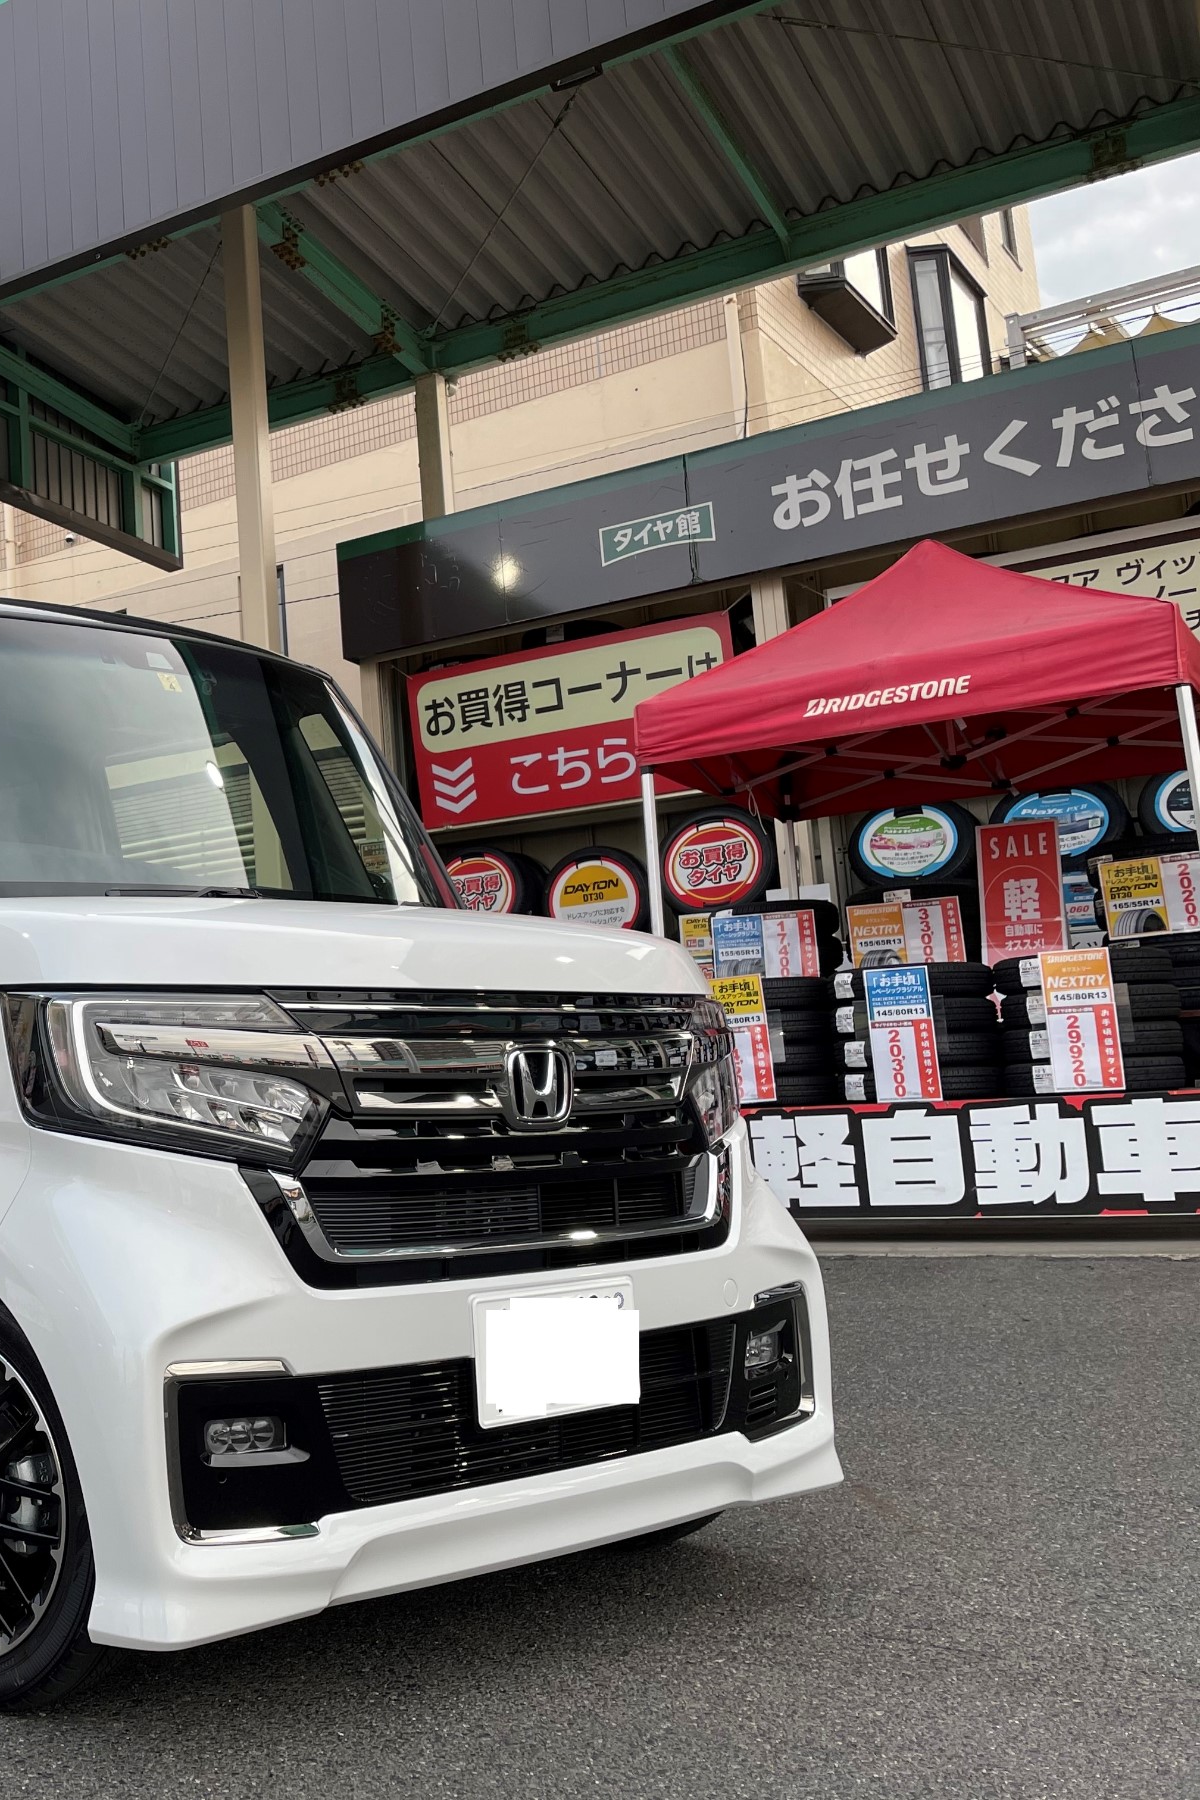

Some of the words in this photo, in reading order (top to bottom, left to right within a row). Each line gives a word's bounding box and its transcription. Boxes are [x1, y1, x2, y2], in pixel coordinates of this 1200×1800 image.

[771, 385, 1198, 530] お任せくださ
[614, 511, 701, 552] タイヤ館
[803, 675, 971, 717] BRIDGESTONE
[510, 738, 637, 795] こちら
[989, 832, 1048, 859] SALE
[680, 841, 748, 869] お買得
[687, 863, 742, 887] タイヤ
[564, 878, 619, 895] DAYTON
[1110, 882, 1158, 893] DAYTON
[462, 893, 497, 911] イヤ
[583, 892, 604, 902] DT30
[1003, 878, 1041, 921] 軽
[1110, 891, 1133, 899] DT30
[1113, 898, 1161, 909] 165/55R14
[853, 924, 901, 937] NEXTRY
[946, 902, 960, 963] お手頃価格タイ
[1005, 924, 1044, 937] 自動車に
[859, 938, 902, 947] 155/65R13
[1005, 938, 1045, 951] オススメ!
[720, 949, 760, 957] 155/65R13
[1047, 952, 1104, 964] BRIDGESTONE
[1046, 974, 1105, 989] NEXTRY
[723, 999, 758, 1007] AYTON
[1053, 991, 1107, 1001] 145/80R13
[726, 1015, 761, 1024] 5/80R13
[876, 1008, 925, 1017] 145/80R13
[919, 1022, 935, 1094] お手頃価格タイヤ
[1066, 1015, 1087, 1086] 29,920
[888, 1029, 906, 1097] 20,300
[750, 1098, 1200, 1208] 軽自動車
